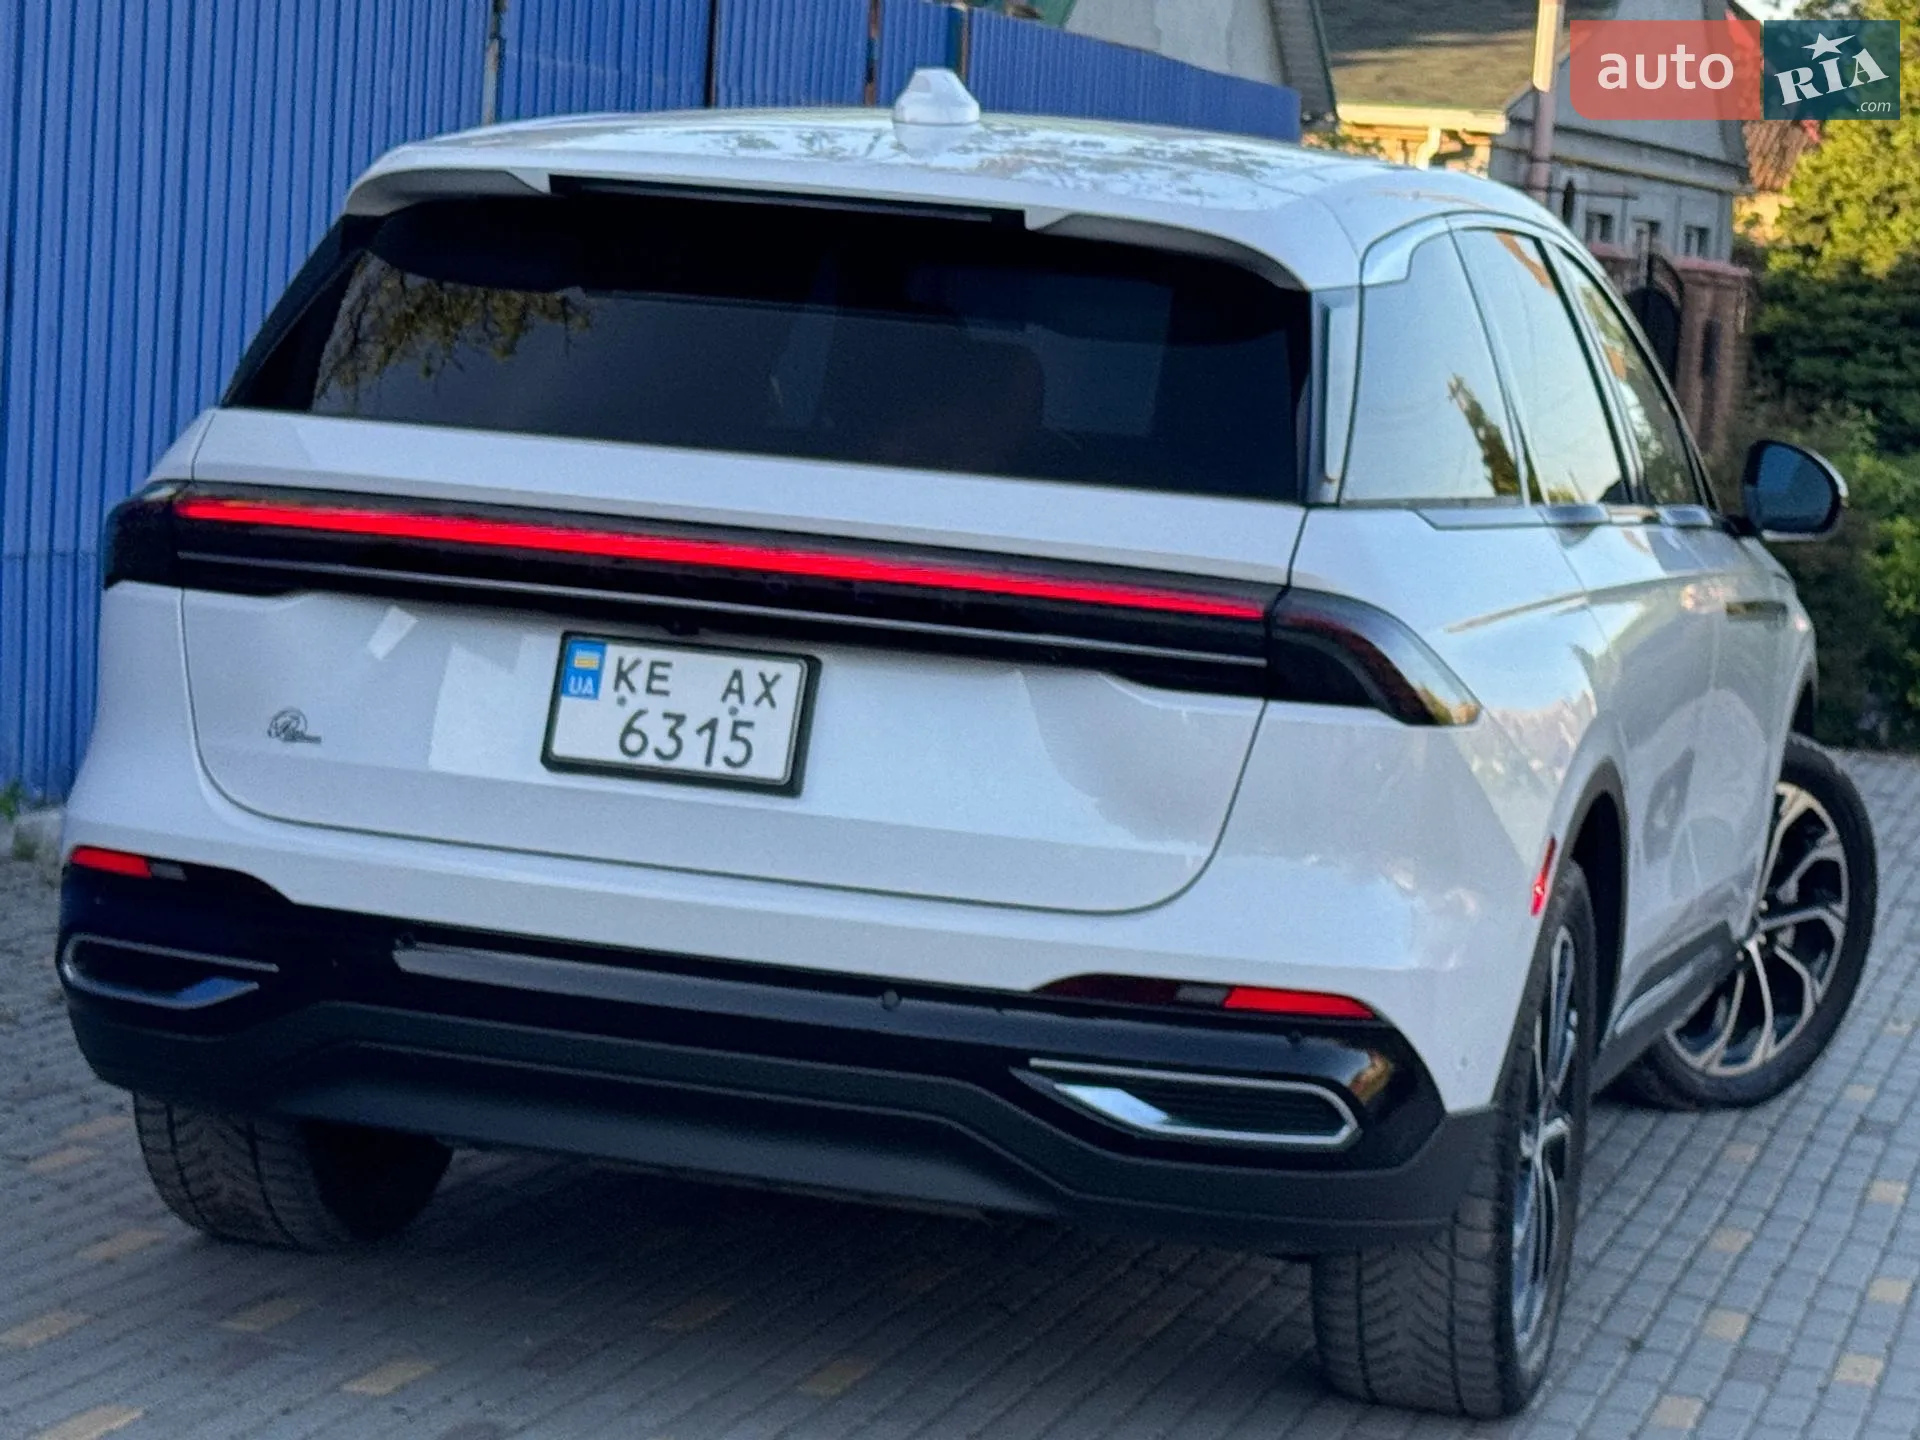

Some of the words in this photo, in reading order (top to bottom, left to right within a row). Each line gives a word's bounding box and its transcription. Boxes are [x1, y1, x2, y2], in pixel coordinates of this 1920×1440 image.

[569, 675, 595, 695] UA
[613, 656, 673, 697] KE
[721, 669, 783, 709] AX
[618, 708, 755, 769] 6315
